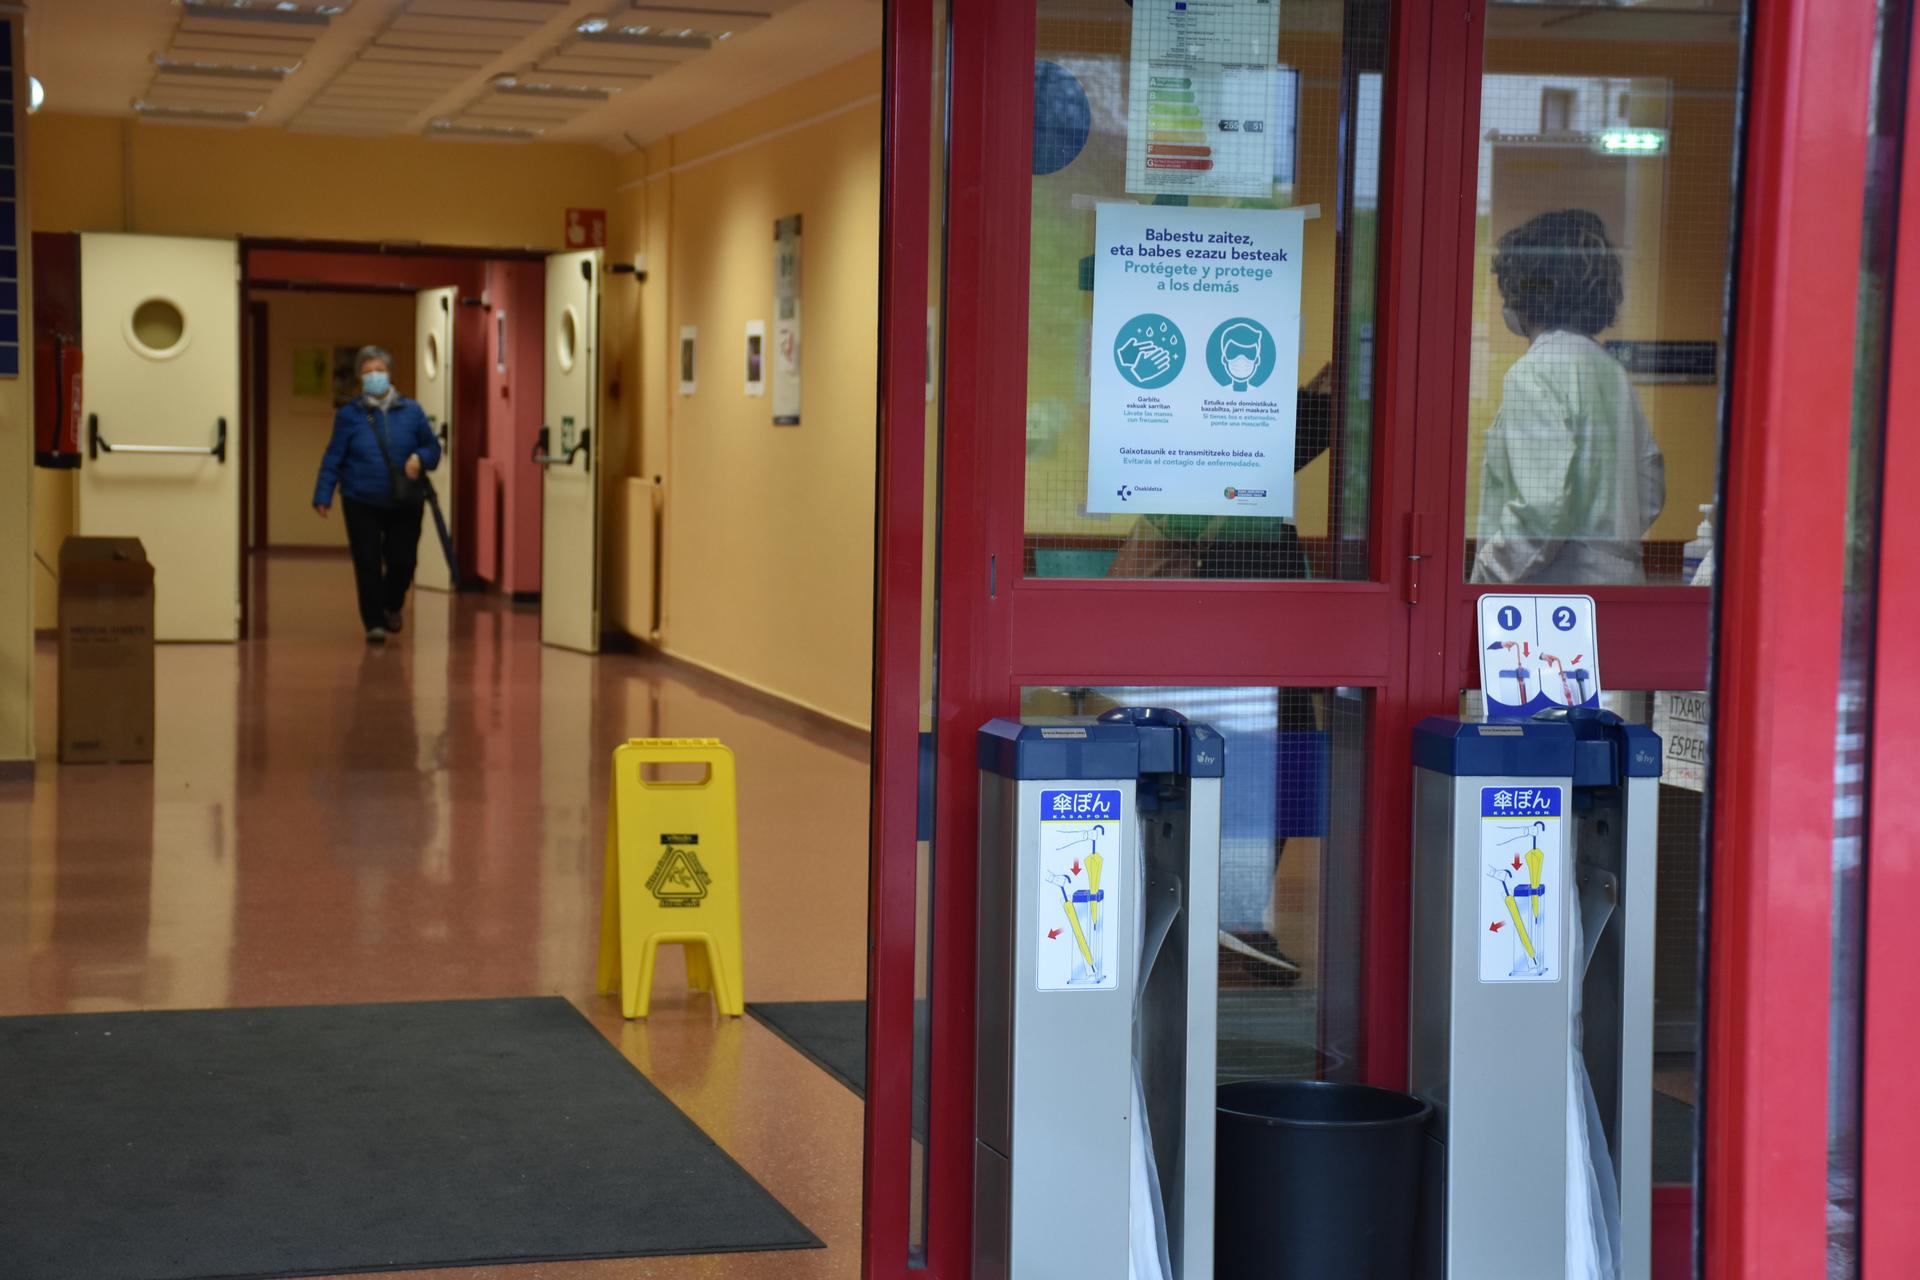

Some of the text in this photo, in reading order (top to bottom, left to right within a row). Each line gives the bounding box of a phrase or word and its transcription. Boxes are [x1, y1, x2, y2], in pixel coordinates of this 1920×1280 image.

[1145, 229, 1254, 246] Babestu zaitez,
[1110, 244, 1288, 262] eta babes ezazu besteak
[1124, 261, 1273, 281] Protégete y protege
[1157, 278, 1240, 293] a los demás
[1119, 447, 1166, 456] Gaixotasunik
[1178, 449, 1231, 457] transmititzeko
[1232, 450, 1253, 458] bidea
[1254, 450, 1266, 458] da.
[1123, 457, 1152, 465] Evitarás
[1162, 458, 1195, 468] contagio
[1504, 610, 1514, 627] 1
[1558, 610, 1571, 628] 2
[1053, 793, 1111, 814] 傘ぽん
[1493, 789, 1551, 811] 傘ぽん
